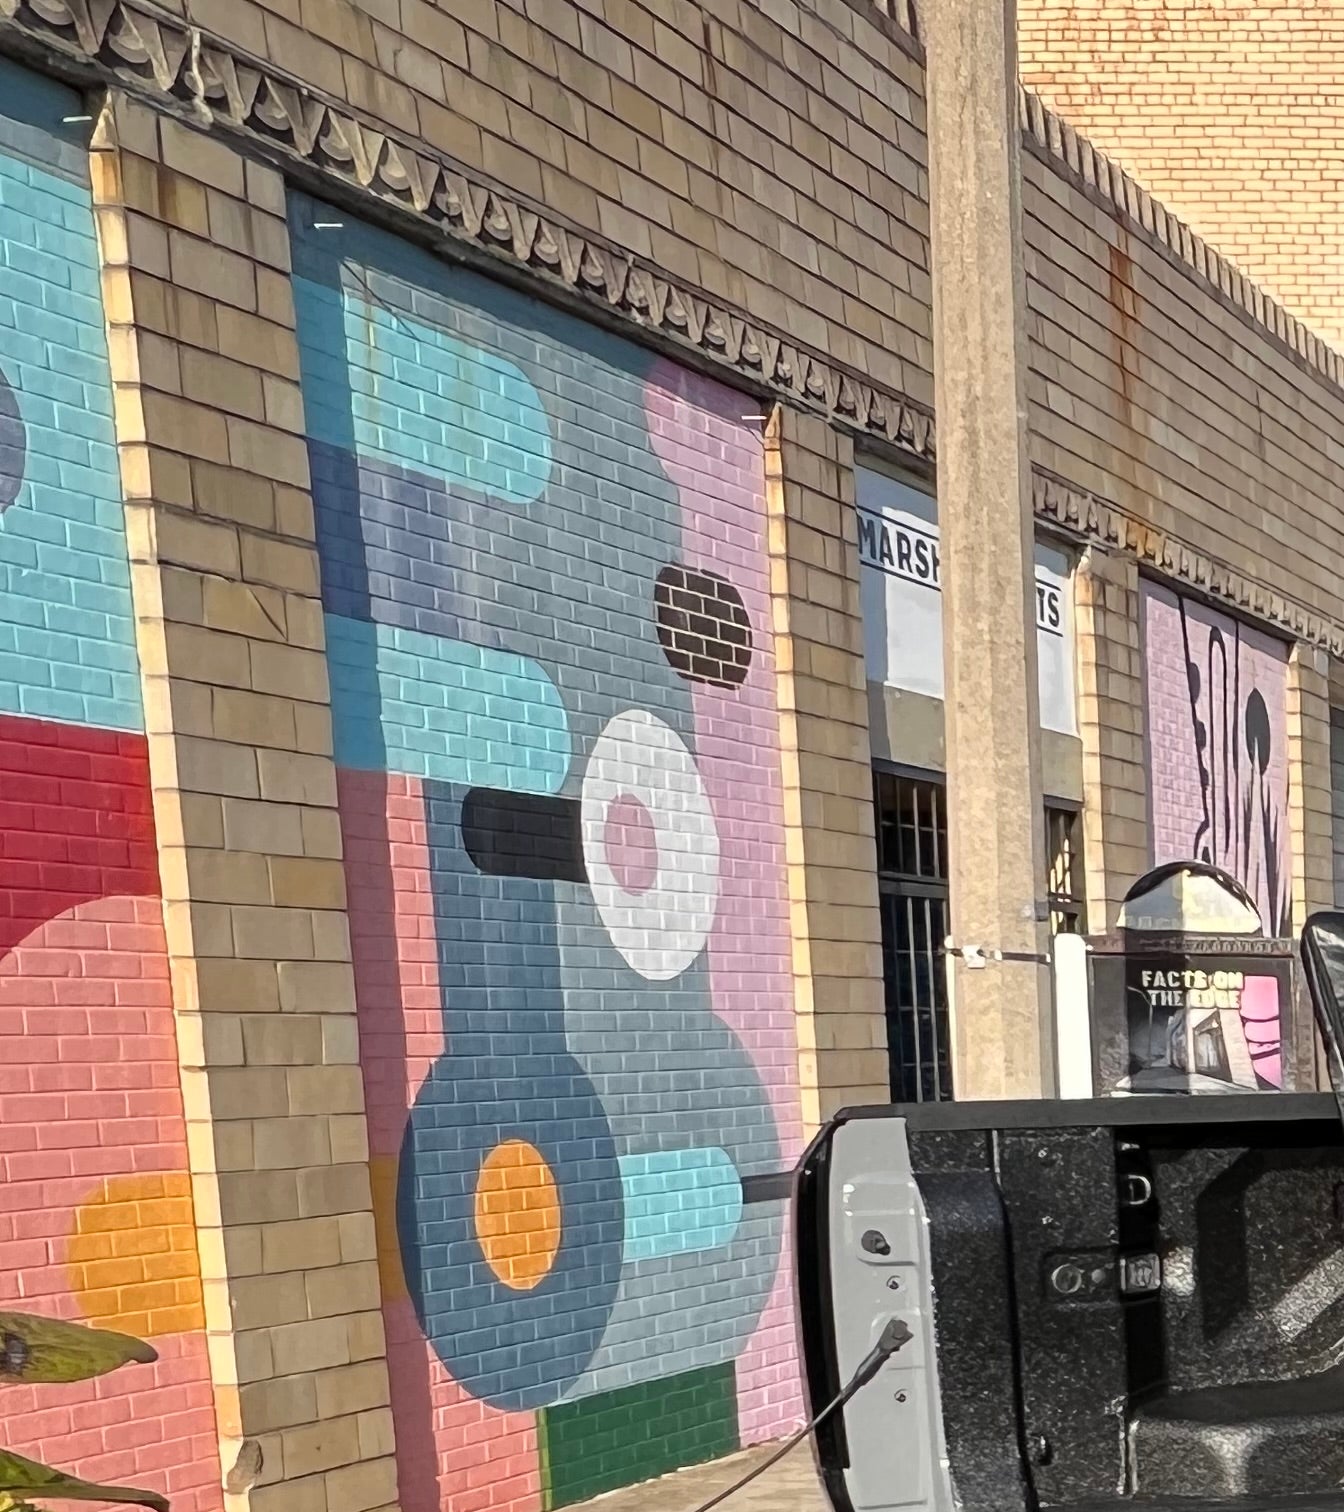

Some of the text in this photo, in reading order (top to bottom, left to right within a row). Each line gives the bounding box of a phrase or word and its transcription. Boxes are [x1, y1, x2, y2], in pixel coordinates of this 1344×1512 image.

[1141, 970, 1244, 990] FACTS ON
[1147, 989, 1184, 1007] THE
